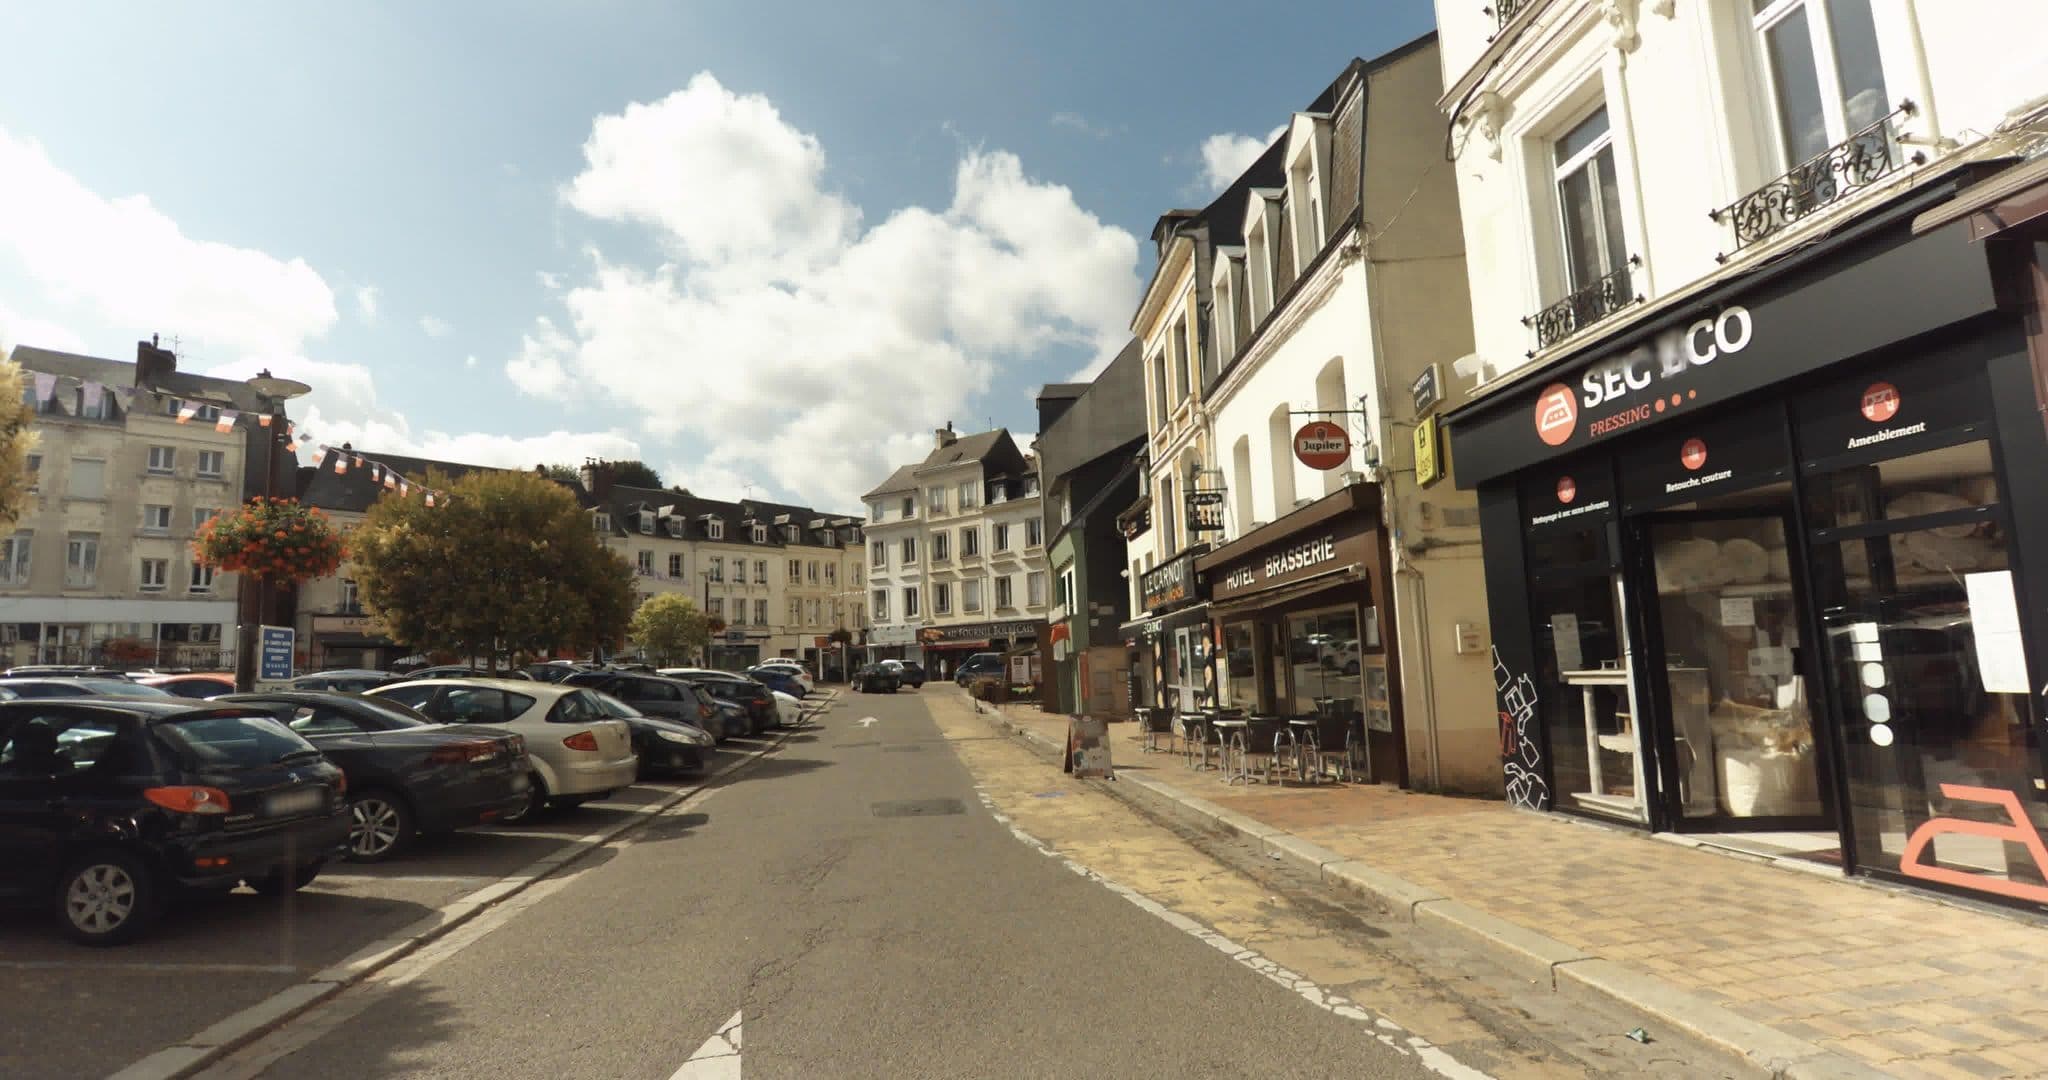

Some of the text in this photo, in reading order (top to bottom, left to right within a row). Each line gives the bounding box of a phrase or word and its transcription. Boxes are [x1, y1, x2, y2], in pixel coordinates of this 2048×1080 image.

[1582, 348, 1652, 408] SEC
[1590, 404, 1650, 437] PRESSING
[1848, 422, 1926, 449] Ameublement
[1304, 440, 1342, 452] Jupiler
[1701, 470, 1732, 485] couture
[1144, 559, 1185, 595] LE CARNOT
[1226, 535, 1336, 590] HOTEL BRASSERIE
